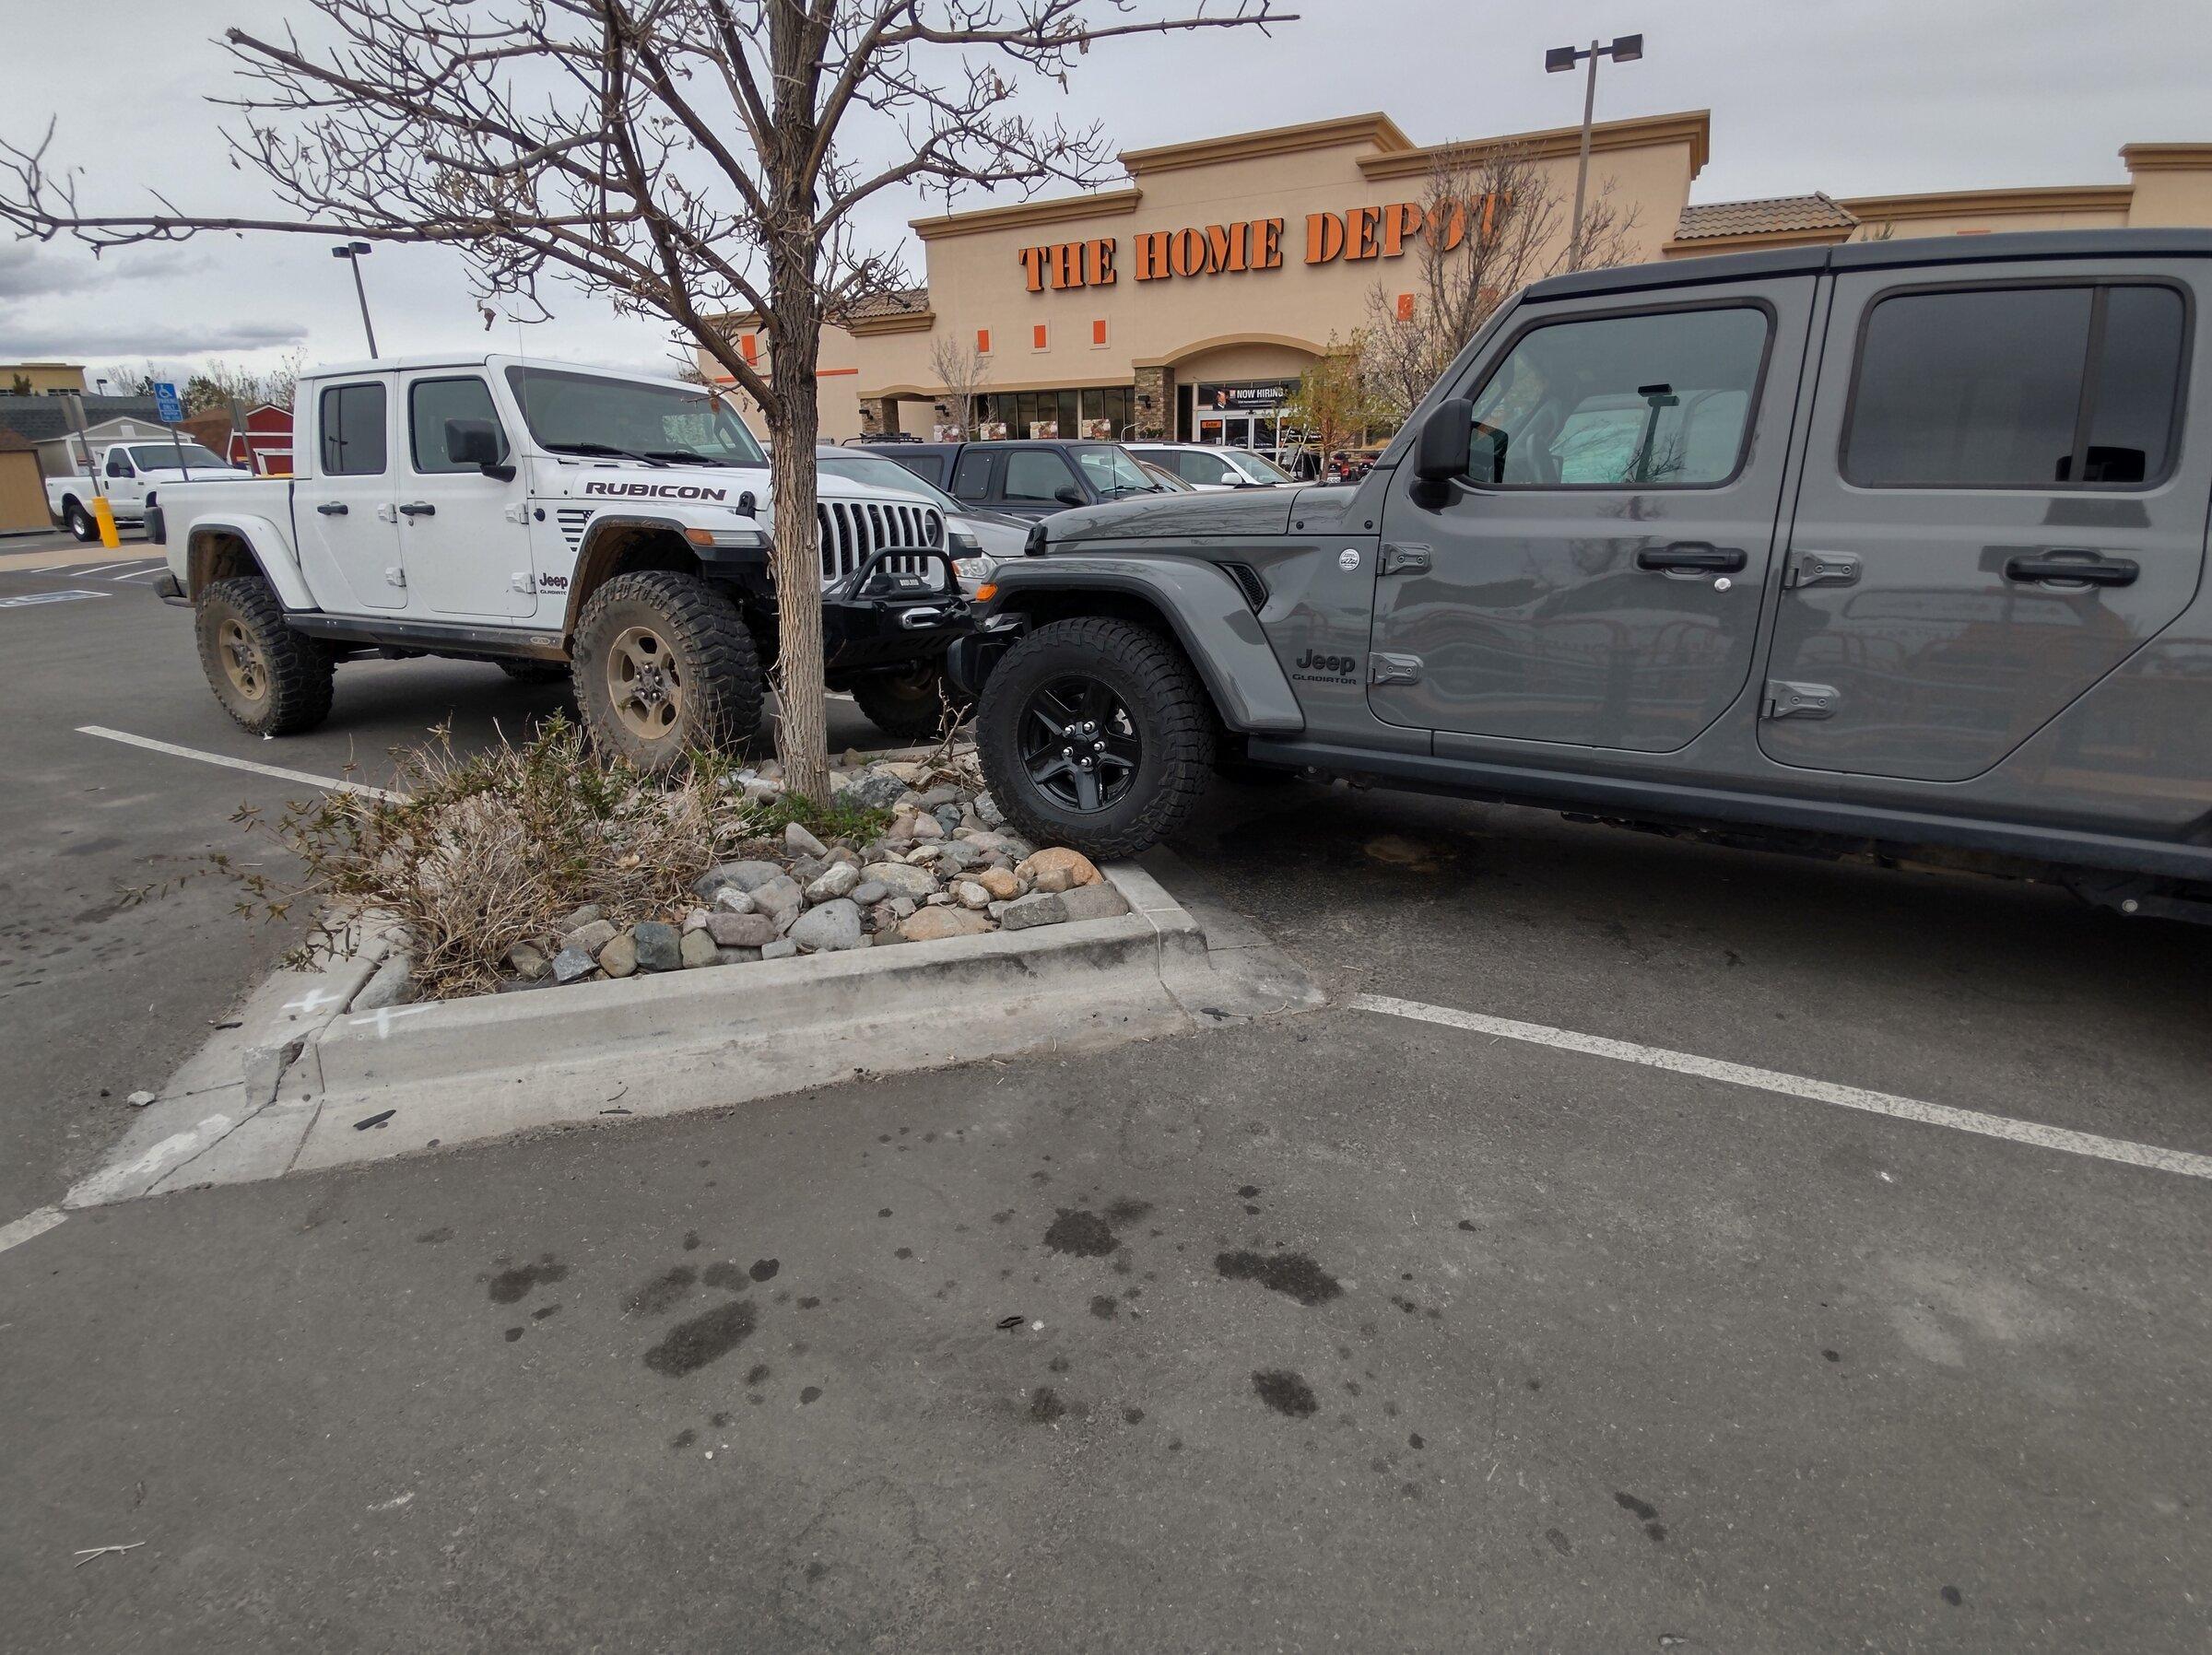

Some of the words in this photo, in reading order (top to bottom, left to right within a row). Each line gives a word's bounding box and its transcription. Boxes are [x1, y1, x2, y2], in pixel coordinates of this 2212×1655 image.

[1018, 236, 1118, 293] THE
[1133, 217, 1286, 282] HOME
[1303, 188, 1512, 265] DEPOT
[1237, 389, 1255, 399] NOW
[1256, 387, 1284, 398] HIRING
[585, 481, 727, 502] RUBICON
[539, 572, 569, 590] Jeep
[1296, 649, 1356, 676] Jeep
[1291, 674, 1358, 686] GLADIATOR
